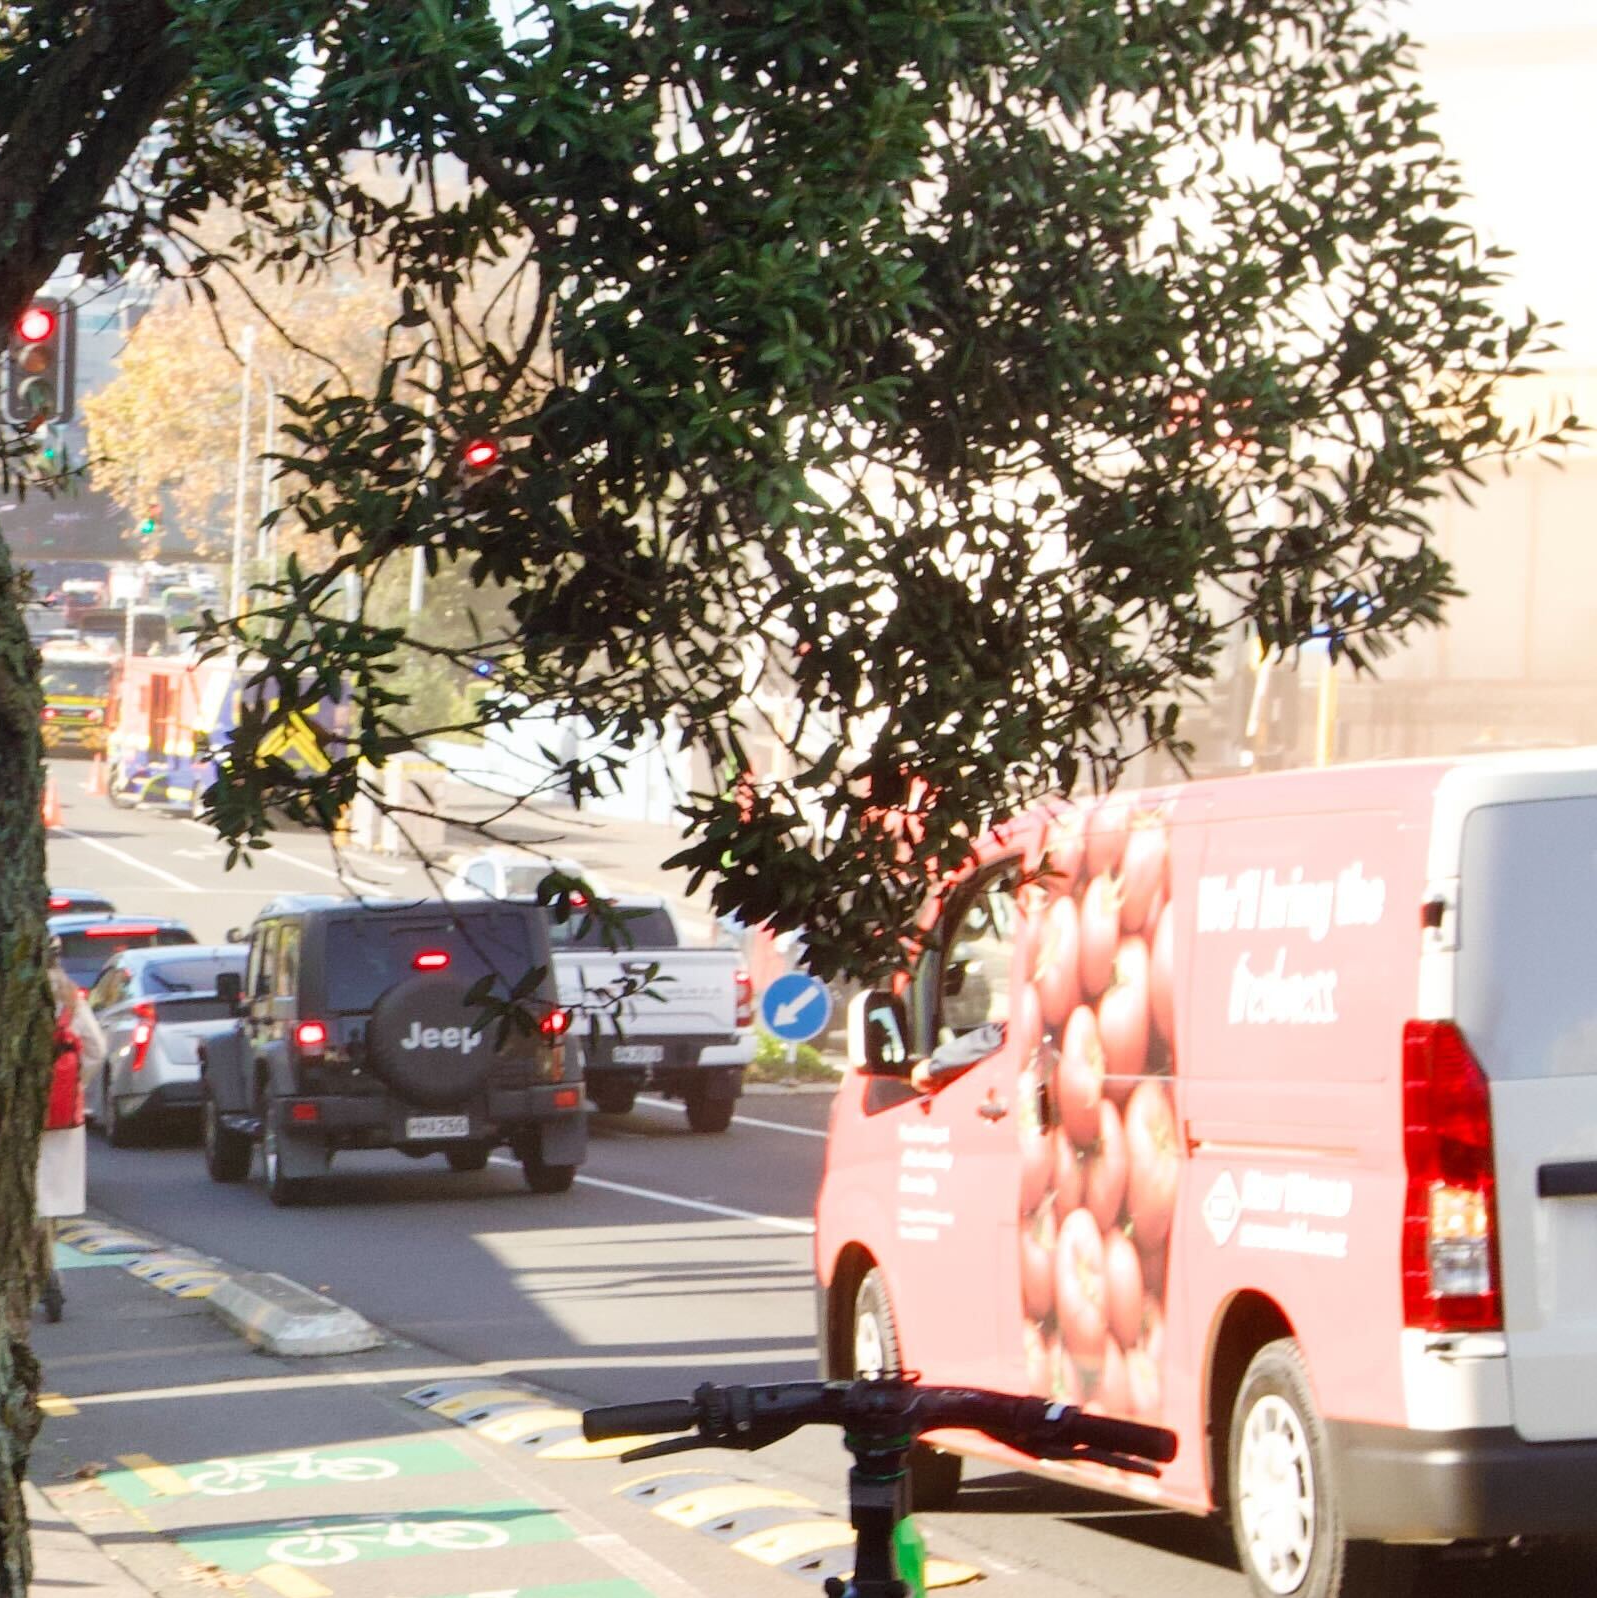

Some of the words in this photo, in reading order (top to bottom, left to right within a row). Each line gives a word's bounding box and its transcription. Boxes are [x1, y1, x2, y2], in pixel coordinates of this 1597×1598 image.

[1258, 866, 1334, 941] bring
[1334, 861, 1386, 927] the
[400, 1021, 483, 1055] Jeep
